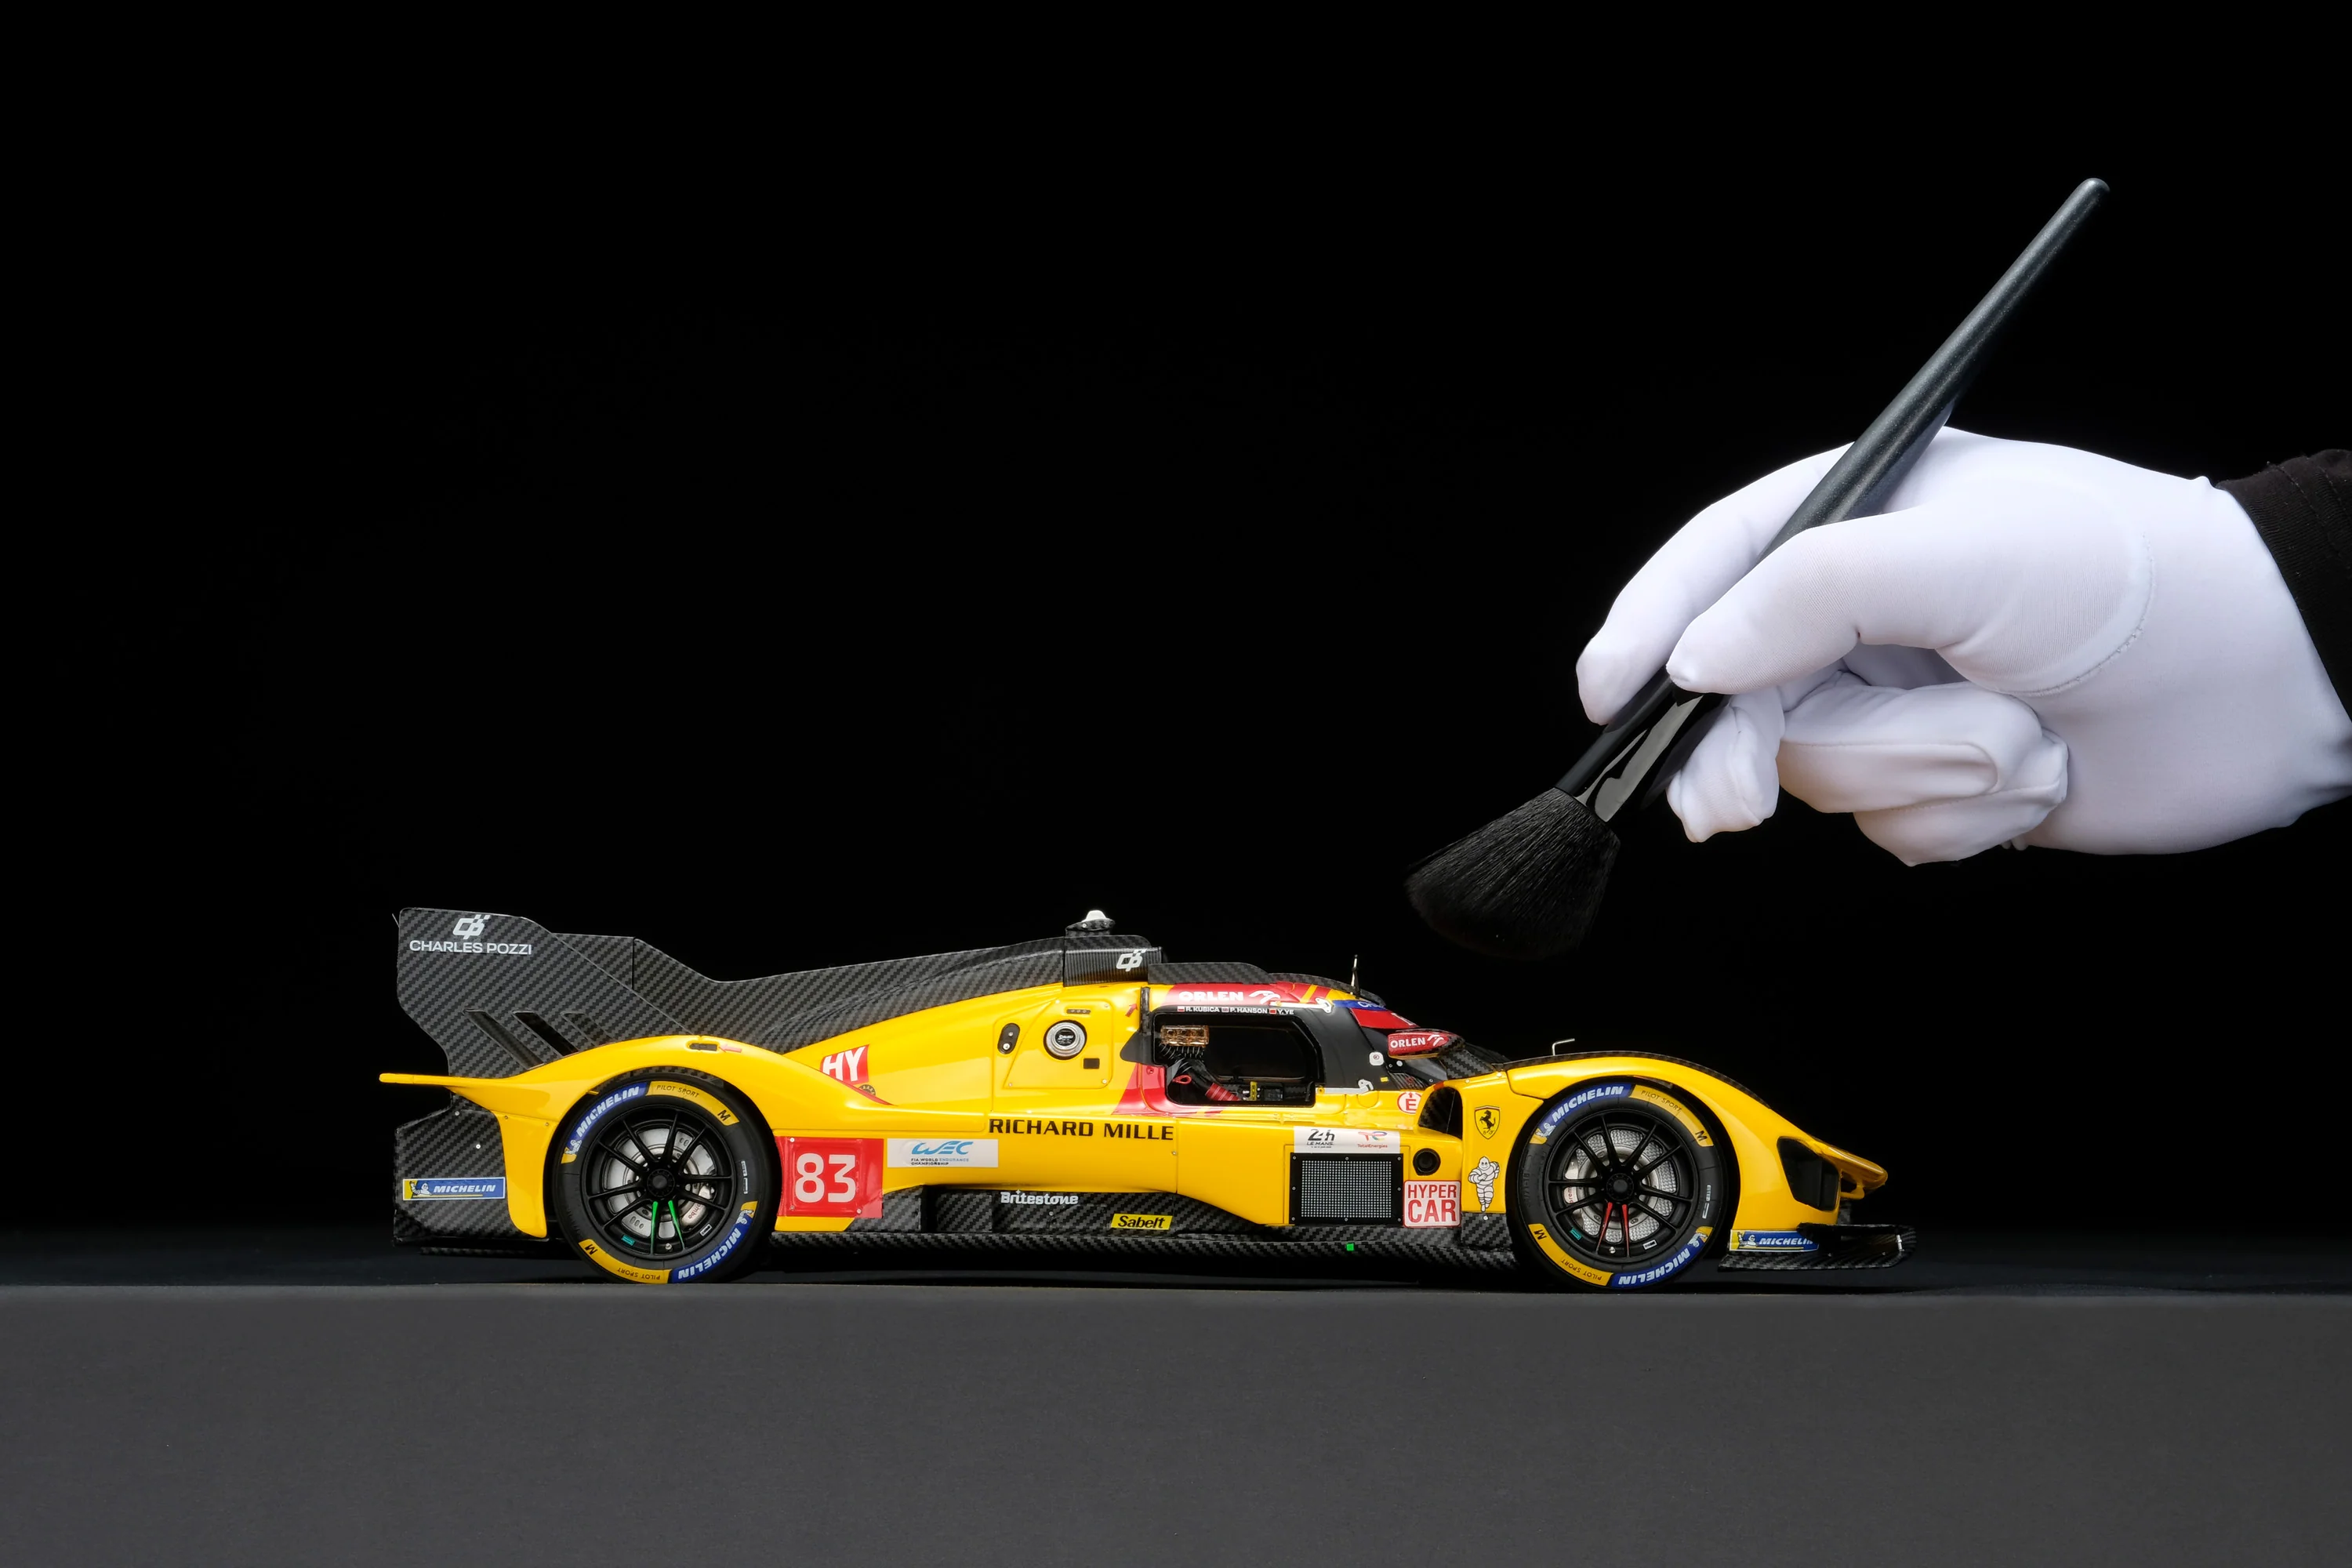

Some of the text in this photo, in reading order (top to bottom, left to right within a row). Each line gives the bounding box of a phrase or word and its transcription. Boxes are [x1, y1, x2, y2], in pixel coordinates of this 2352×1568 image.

[409, 940, 532, 955] CHARLES POZZI
[1178, 991, 1244, 1002] ORLEN
[1390, 1037, 1425, 1048] ORLEN
[822, 1046, 866, 1082] HY
[678, 1087, 700, 1098] SPORT
[1406, 1098, 1417, 1111] E
[1552, 1085, 1624, 1123] MICHELIN
[1641, 1090, 1682, 1112] PILOT SPORT
[576, 1086, 640, 1138] MICHELIN
[717, 1109, 731, 1122] M
[989, 1118, 1174, 1141] RICHARD MILLE
[1694, 1130, 1708, 1142] M
[912, 1141, 974, 1155] WEC
[795, 1152, 856, 1203] 83
[1000, 1189, 1079, 1205] Britestone
[1408, 1185, 1457, 1199] HYPER
[1408, 1200, 1457, 1223] CAR
[1118, 1215, 1166, 1229] Sabelt
[1533, 1229, 1548, 1240] M
[585, 1243, 598, 1255] M
[678, 1227, 742, 1279] MICHELIN
[616, 1268, 639, 1277] SPORT
[1560, 1258, 1602, 1281] PILOT SPORT
[1618, 1247, 1691, 1285] MICHELIN
